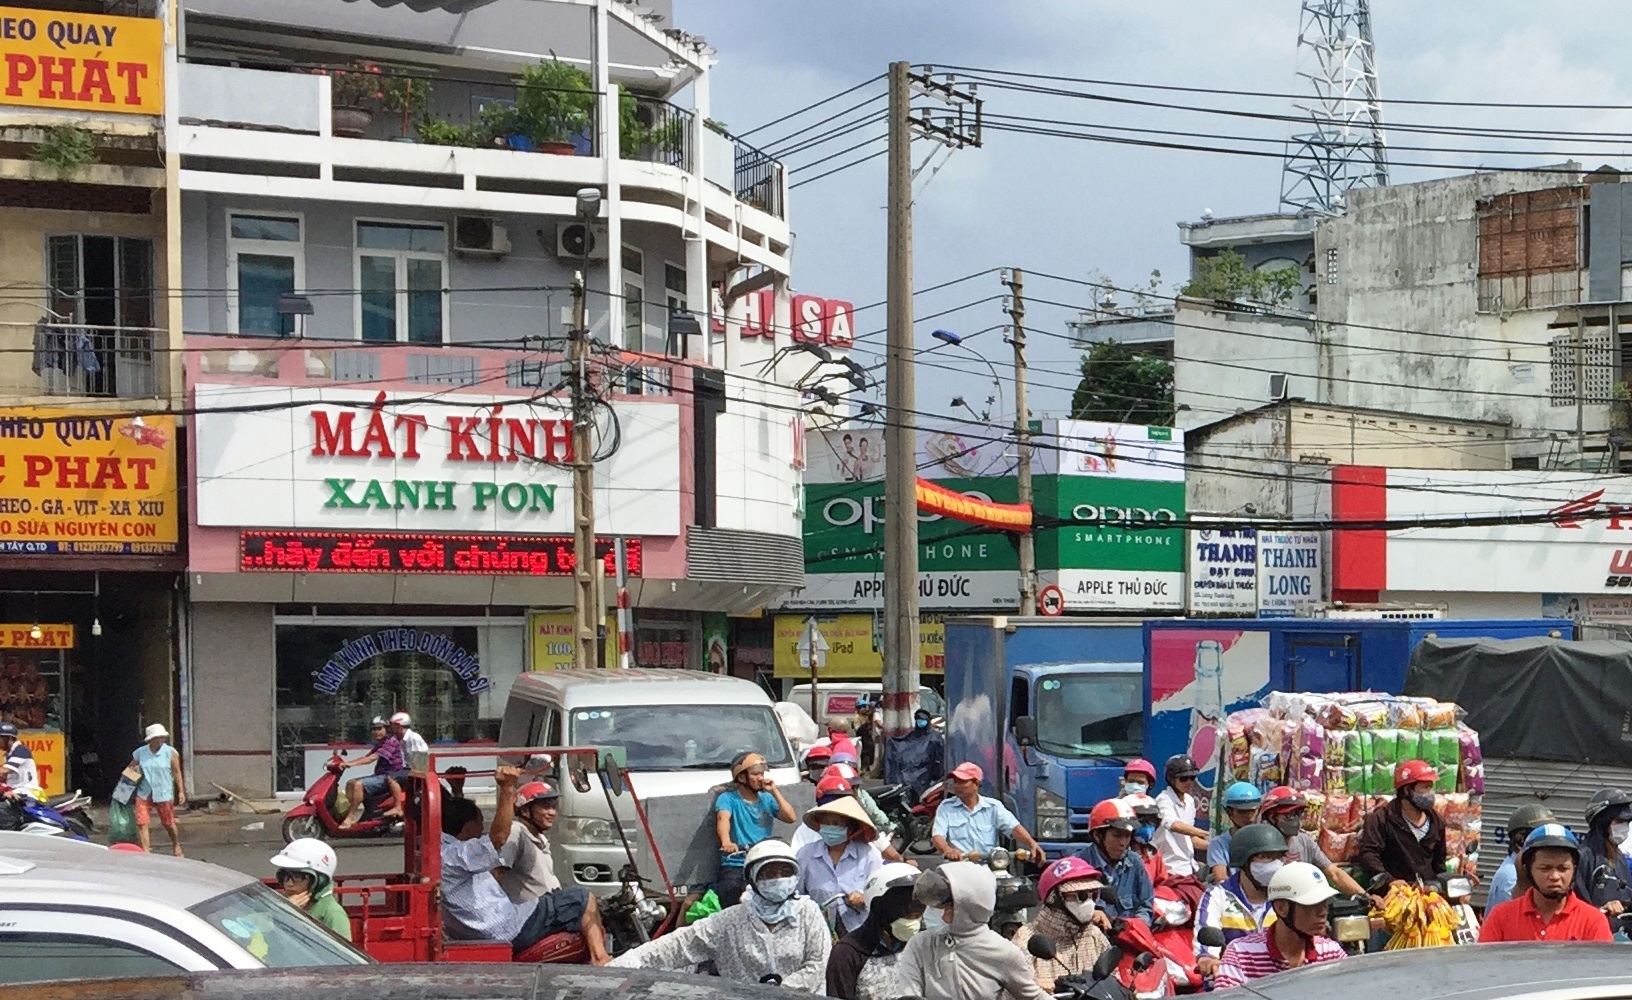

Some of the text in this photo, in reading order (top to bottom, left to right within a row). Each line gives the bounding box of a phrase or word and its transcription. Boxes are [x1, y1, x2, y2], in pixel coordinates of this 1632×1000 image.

[0, 18, 117, 50] EO QUAY
[5, 51, 148, 105] PHÁT
[55, 418, 114, 446] QUAY
[446, 405, 574, 463] KÍNH
[23, 450, 157, 490] PHÁT
[325, 477, 557, 513] XANH PON
[122, 523, 156, 536] CON
[1075, 532, 1171, 545] SMARTPHONE
[1262, 548, 1318, 568] THANH
[938, 576, 970, 597] ĐỨC
[1077, 577, 1168, 596] APPLE THỦ ĐỨC
[1269, 575, 1311, 596] LONG
[377, 628, 418, 651] THEO
[833, 641, 854, 654] iPad
